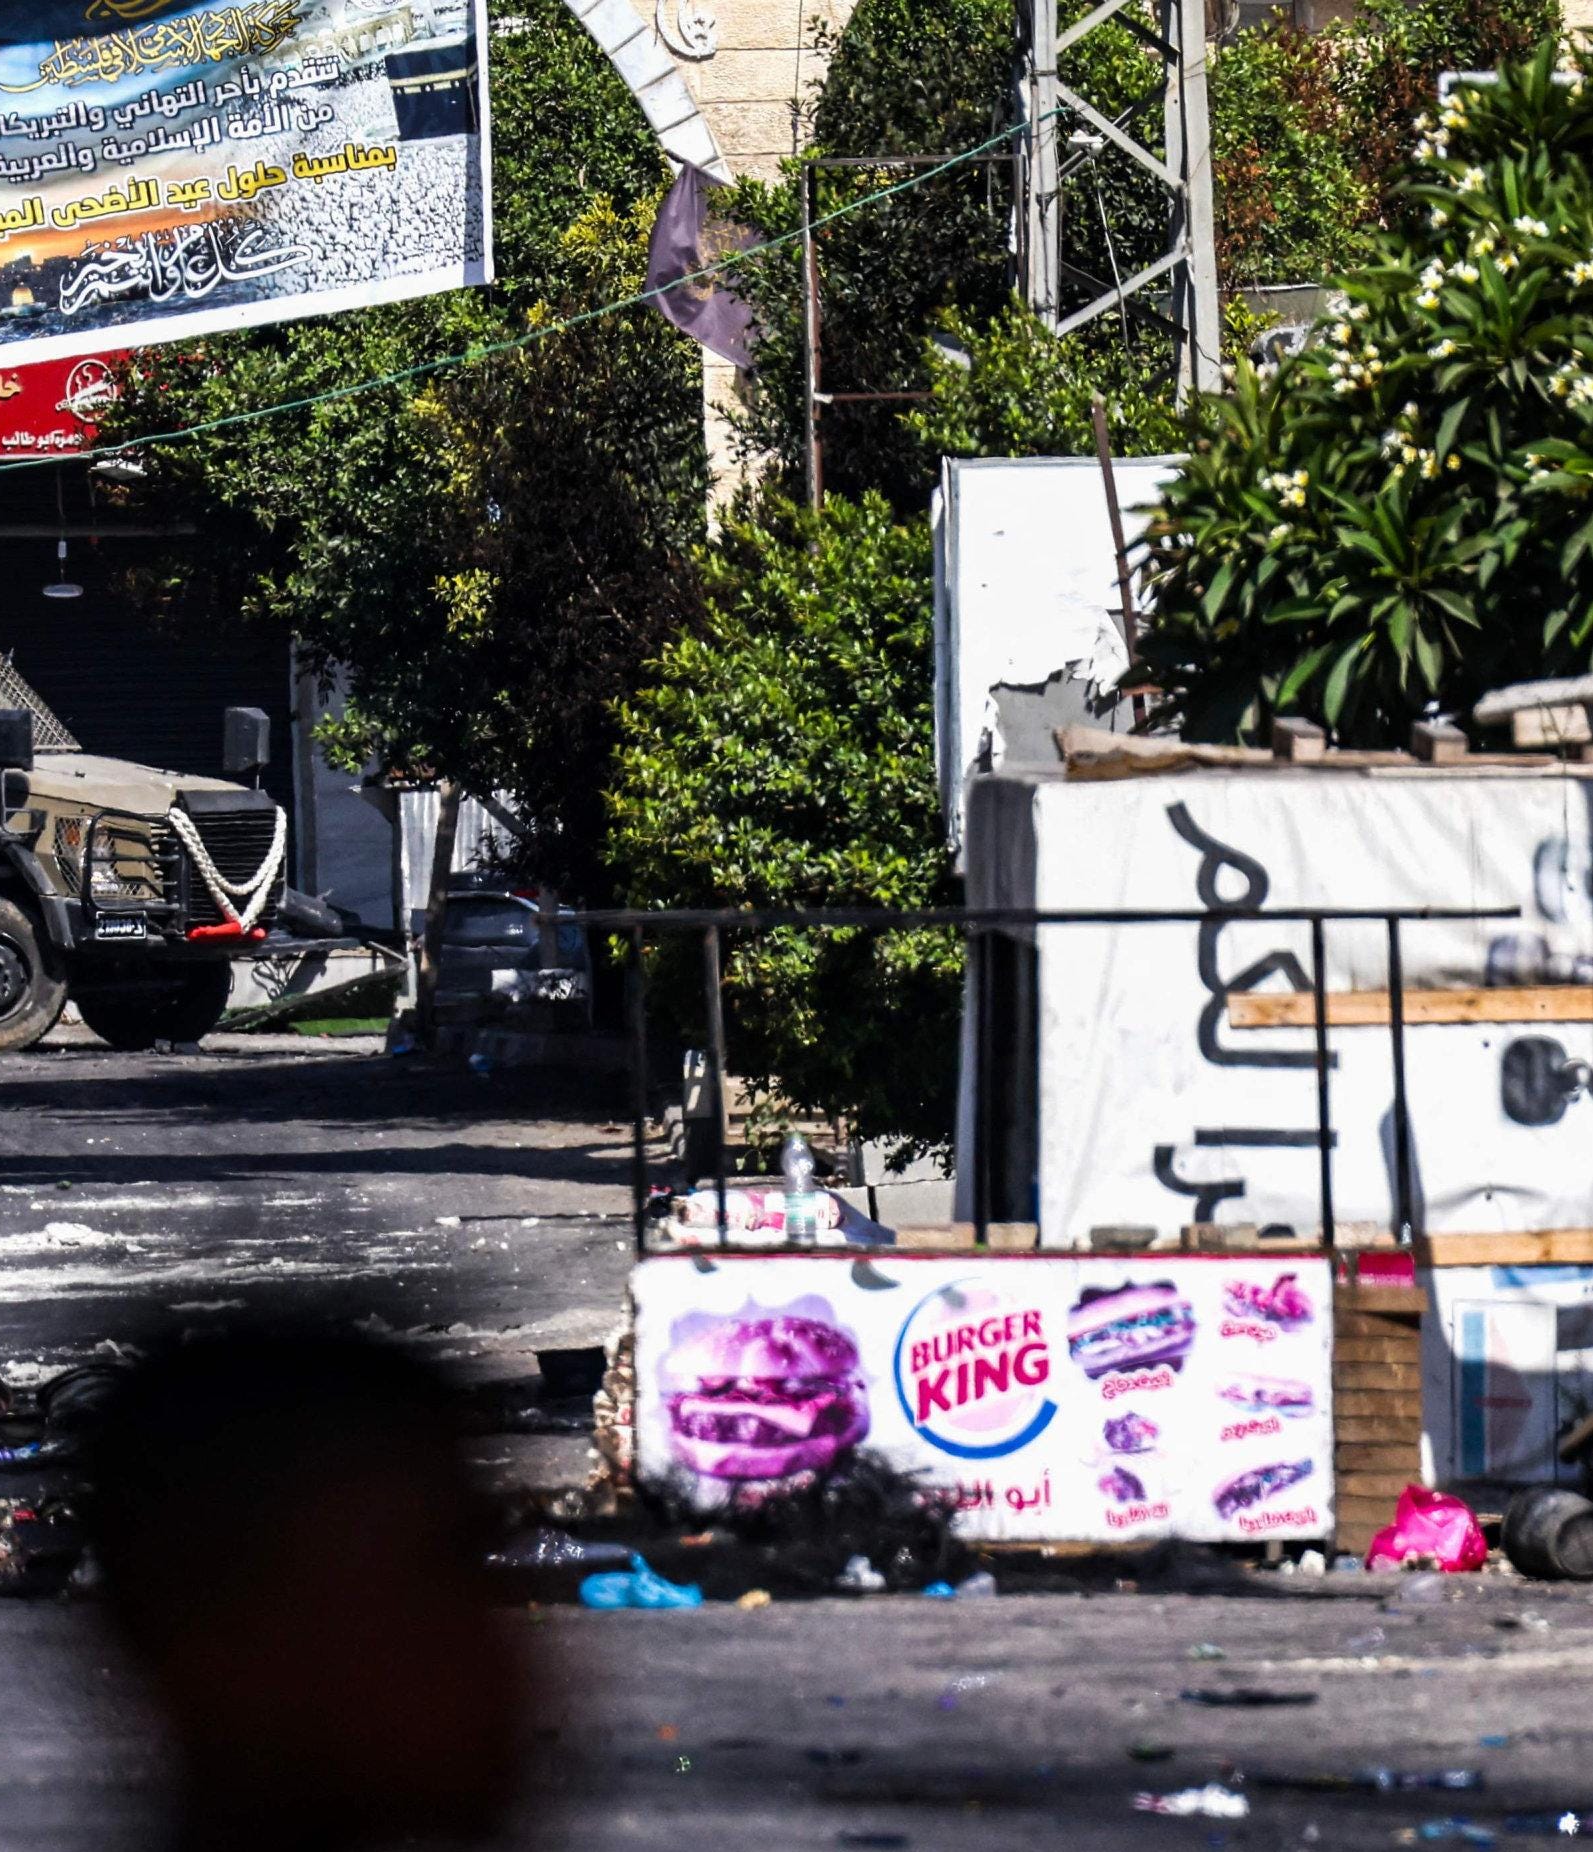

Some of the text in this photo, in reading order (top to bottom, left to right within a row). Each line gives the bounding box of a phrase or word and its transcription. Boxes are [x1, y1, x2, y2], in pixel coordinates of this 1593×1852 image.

[115, 79, 207, 128] التهاني
[214, 62, 261, 109] بأحر
[225, 101, 292, 139] الأمة
[296, 103, 335, 132] من
[101, 118, 221, 165] الإسلامية
[292, 142, 398, 180] بمناسبة
[51, 176, 162, 229] الأضحى
[166, 178, 211, 211] عيد
[216, 164, 284, 202] حلول
[910, 1309, 1042, 1374] BURGER
[917, 1342, 1049, 1422] KING
[1005, 1468, 1051, 1516] أبو
